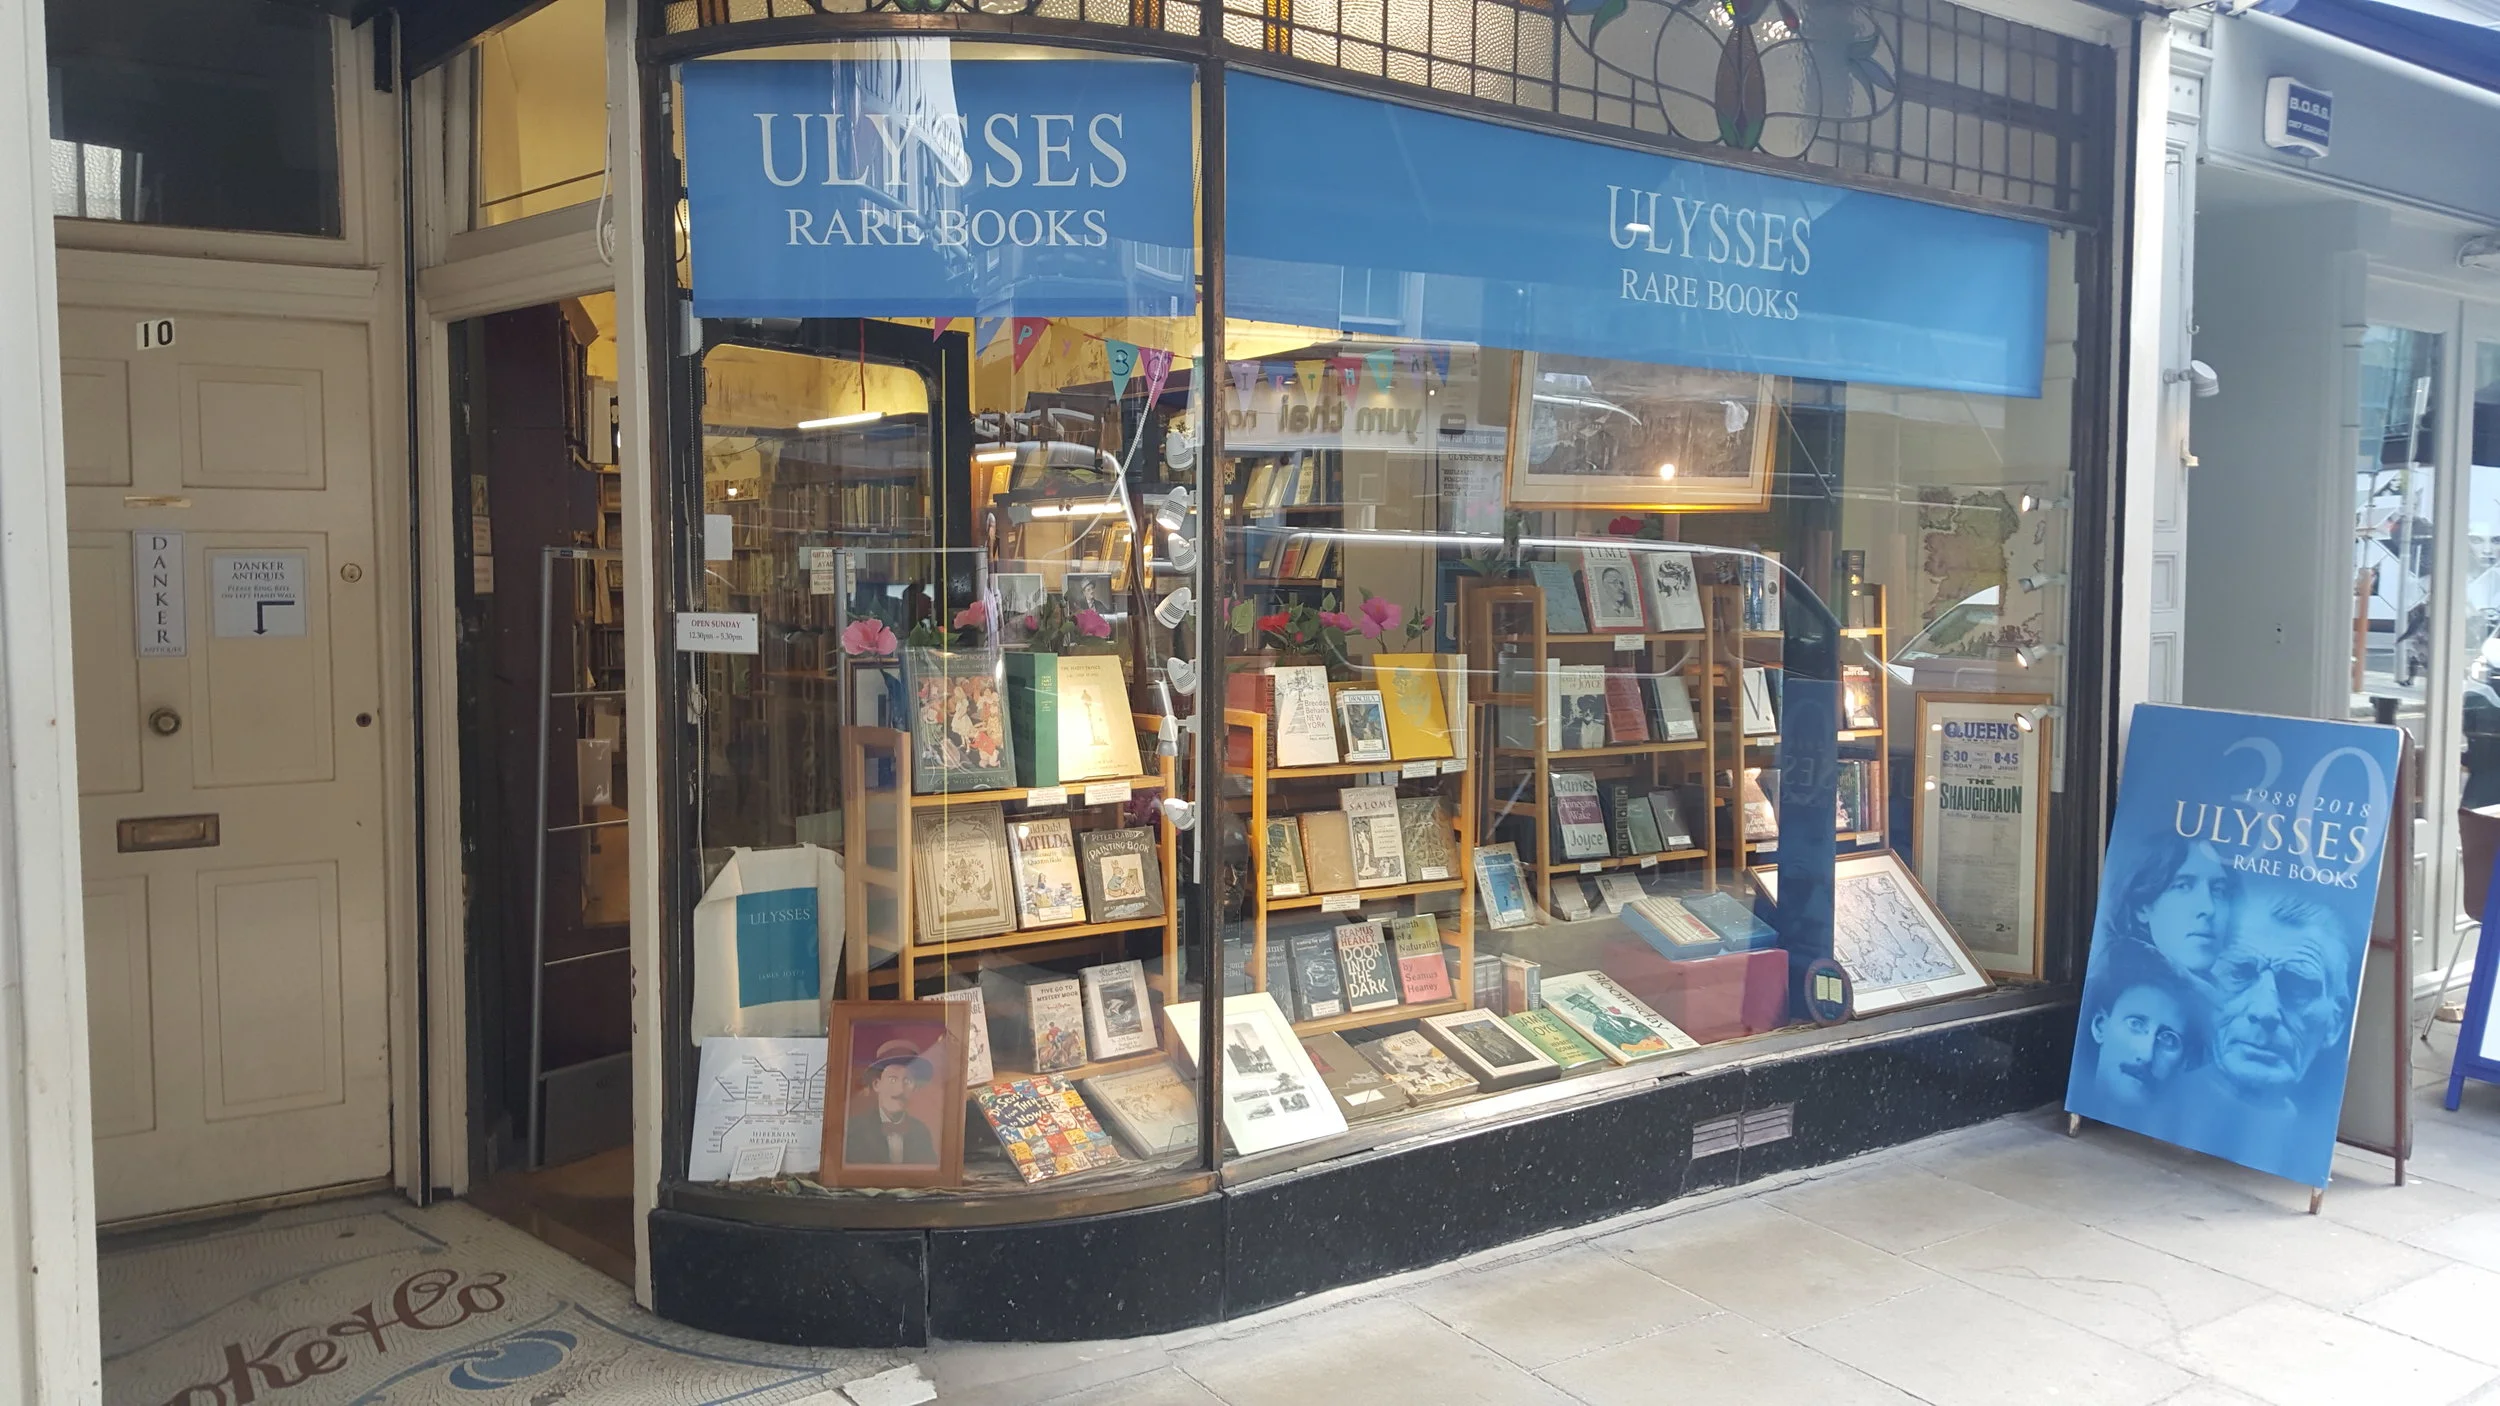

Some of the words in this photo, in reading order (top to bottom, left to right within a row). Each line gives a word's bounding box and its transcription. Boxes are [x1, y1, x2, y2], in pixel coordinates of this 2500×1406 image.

[753, 112, 1127, 189] ULYSSES
[786, 209, 924, 247] RARE
[936, 209, 1109, 248] BOOKS
[1606, 184, 1811, 275] ULYSSES
[1620, 268, 1698, 308] RARE
[1706, 280, 1799, 321] BOOKS
[142, 319, 174, 348] 10
[232, 560, 285, 572] DANKER
[231, 571, 286, 581] ANTIQUES
[151, 535, 173, 645] DANKER
[711, 620, 741, 629] SUNDAY
[1944, 721, 2020, 741] QUEENS
[1555, 776, 1594, 793] James
[1966, 777, 1996, 786] THE
[2244, 787, 2297, 808] 1988
[2313, 796, 2372, 819] 2018
[1570, 829, 1604, 851] Joyce
[2175, 800, 2369, 865] ULYSSES
[1089, 841, 1126, 859] PAINTING
[1126, 840, 1151, 853] BOOK
[2234, 854, 2281, 877] RARE
[2288, 865, 2359, 890] BOOKS
[749, 908, 811, 926] ULYSSES
[1394, 919, 1419, 930] Death
[1338, 925, 1374, 938] SEAMUS
[1396, 932, 1406, 941] of
[1340, 933, 1375, 946] HEANEY
[1399, 940, 1439, 952] Naturalist
[1342, 944, 1383, 962] DOOR
[1345, 958, 1377, 973] INTO
[1402, 962, 1412, 972] by
[1348, 970, 1372, 984] THE
[1405, 972, 1438, 982] Seamus
[1348, 979, 1389, 998] DARK
[1407, 983, 1438, 994] Heaney
[1036, 993, 1061, 1002] MYSTERY
[1587, 970, 1671, 1031] Bloomsday
[1518, 1013, 1552, 1027] JAMES
[1529, 1024, 1564, 1037] JOYCE
[996, 1091, 1024, 1108] Seuss
[1013, 1097, 1042, 1113] THEN
[990, 1104, 1005, 1118] Dr.
[751, 1130, 797, 1139] HIBERNIAN
